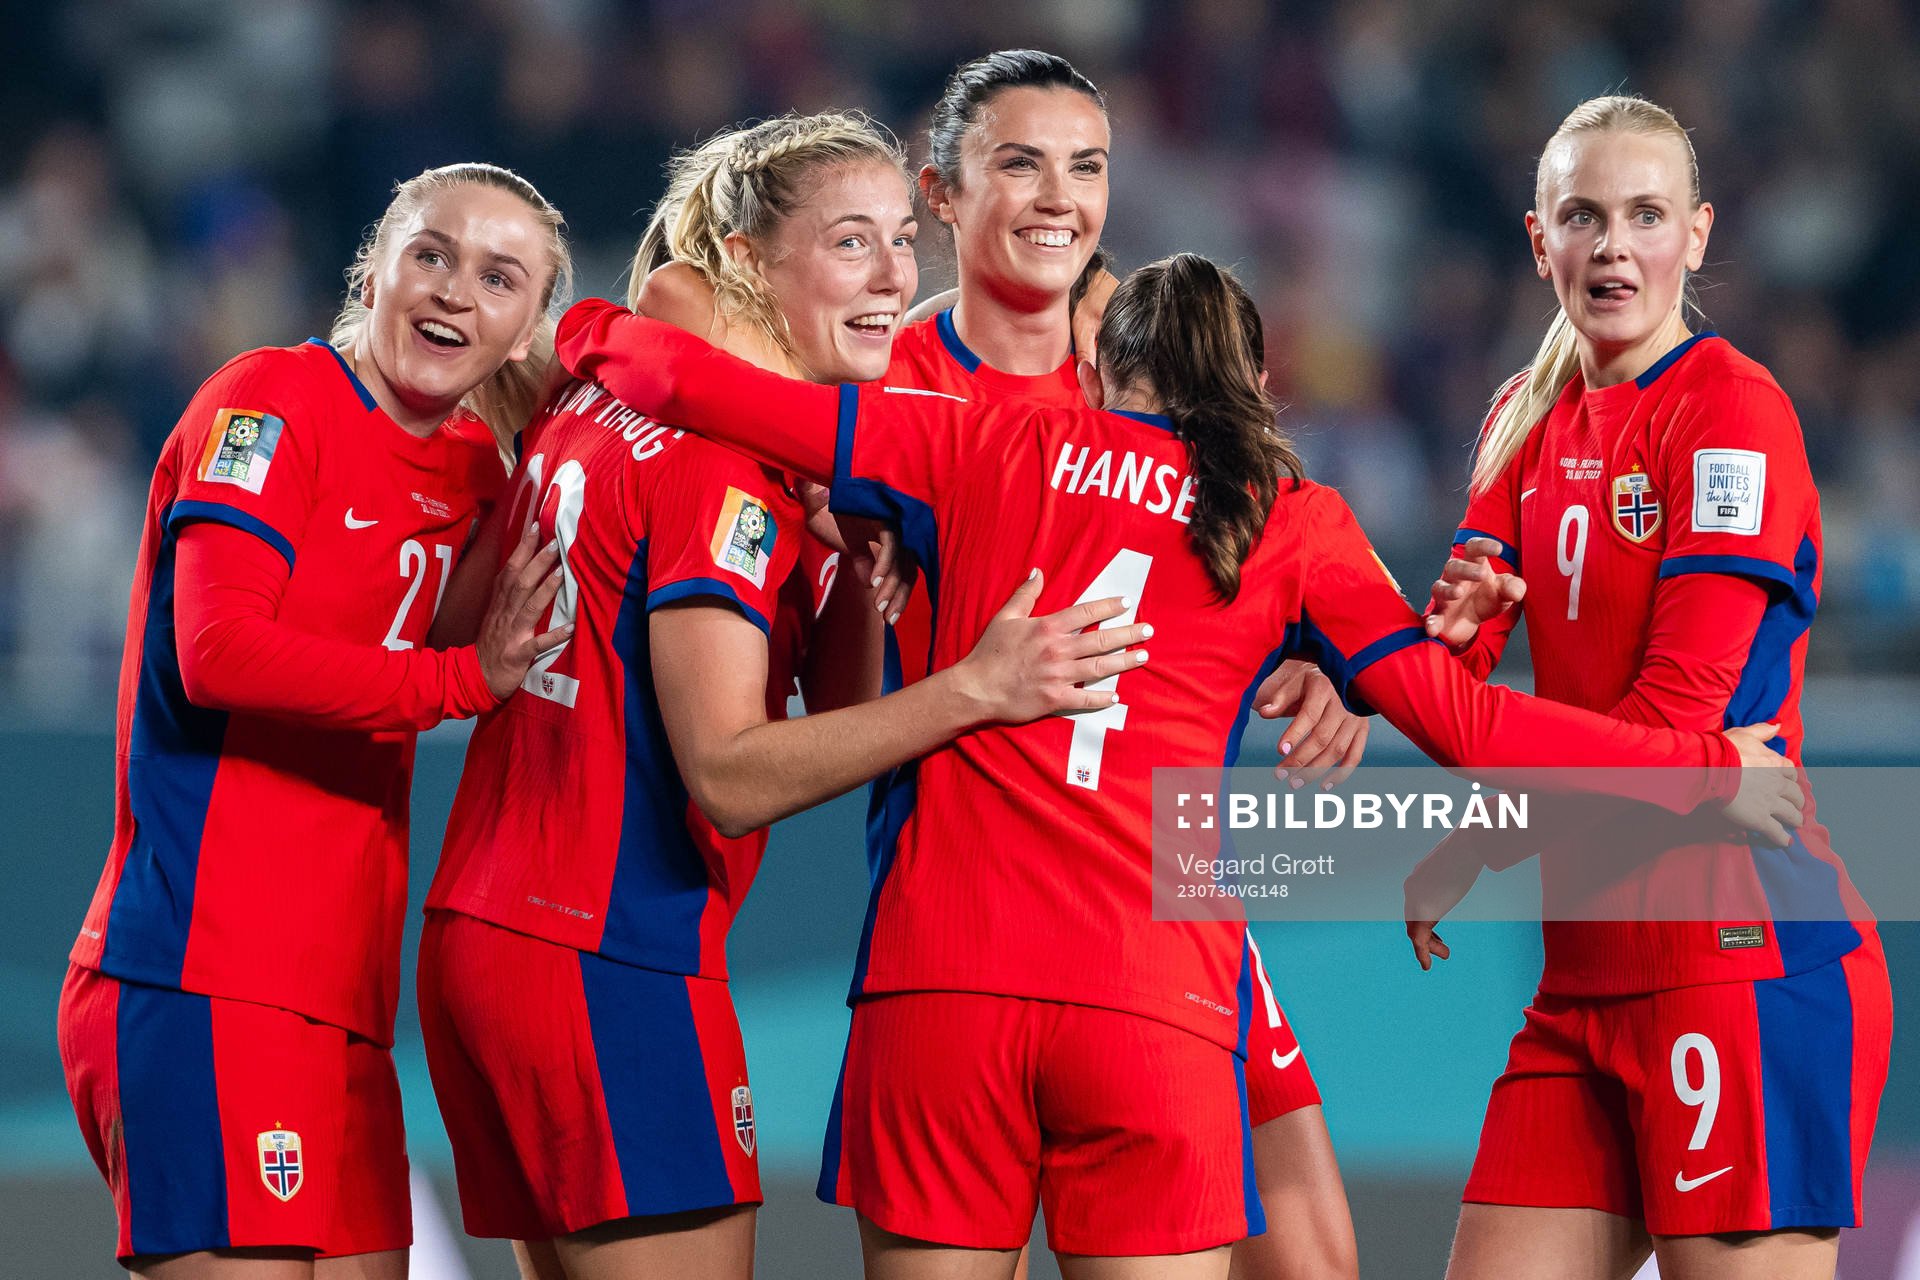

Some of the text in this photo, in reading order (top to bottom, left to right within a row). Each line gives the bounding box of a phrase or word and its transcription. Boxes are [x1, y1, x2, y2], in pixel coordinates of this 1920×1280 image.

[1705, 490, 1722, 502] the
[1709, 463, 1750, 476] FOOTBALL
[1709, 475, 1750, 491] UNITES
[1719, 507, 1738, 516] FIFA
[381, 539, 453, 651] 21
[1556, 505, 1588, 621] 9
[1054, 547, 1154, 791] 4
[1671, 1032, 1721, 1150] 9
